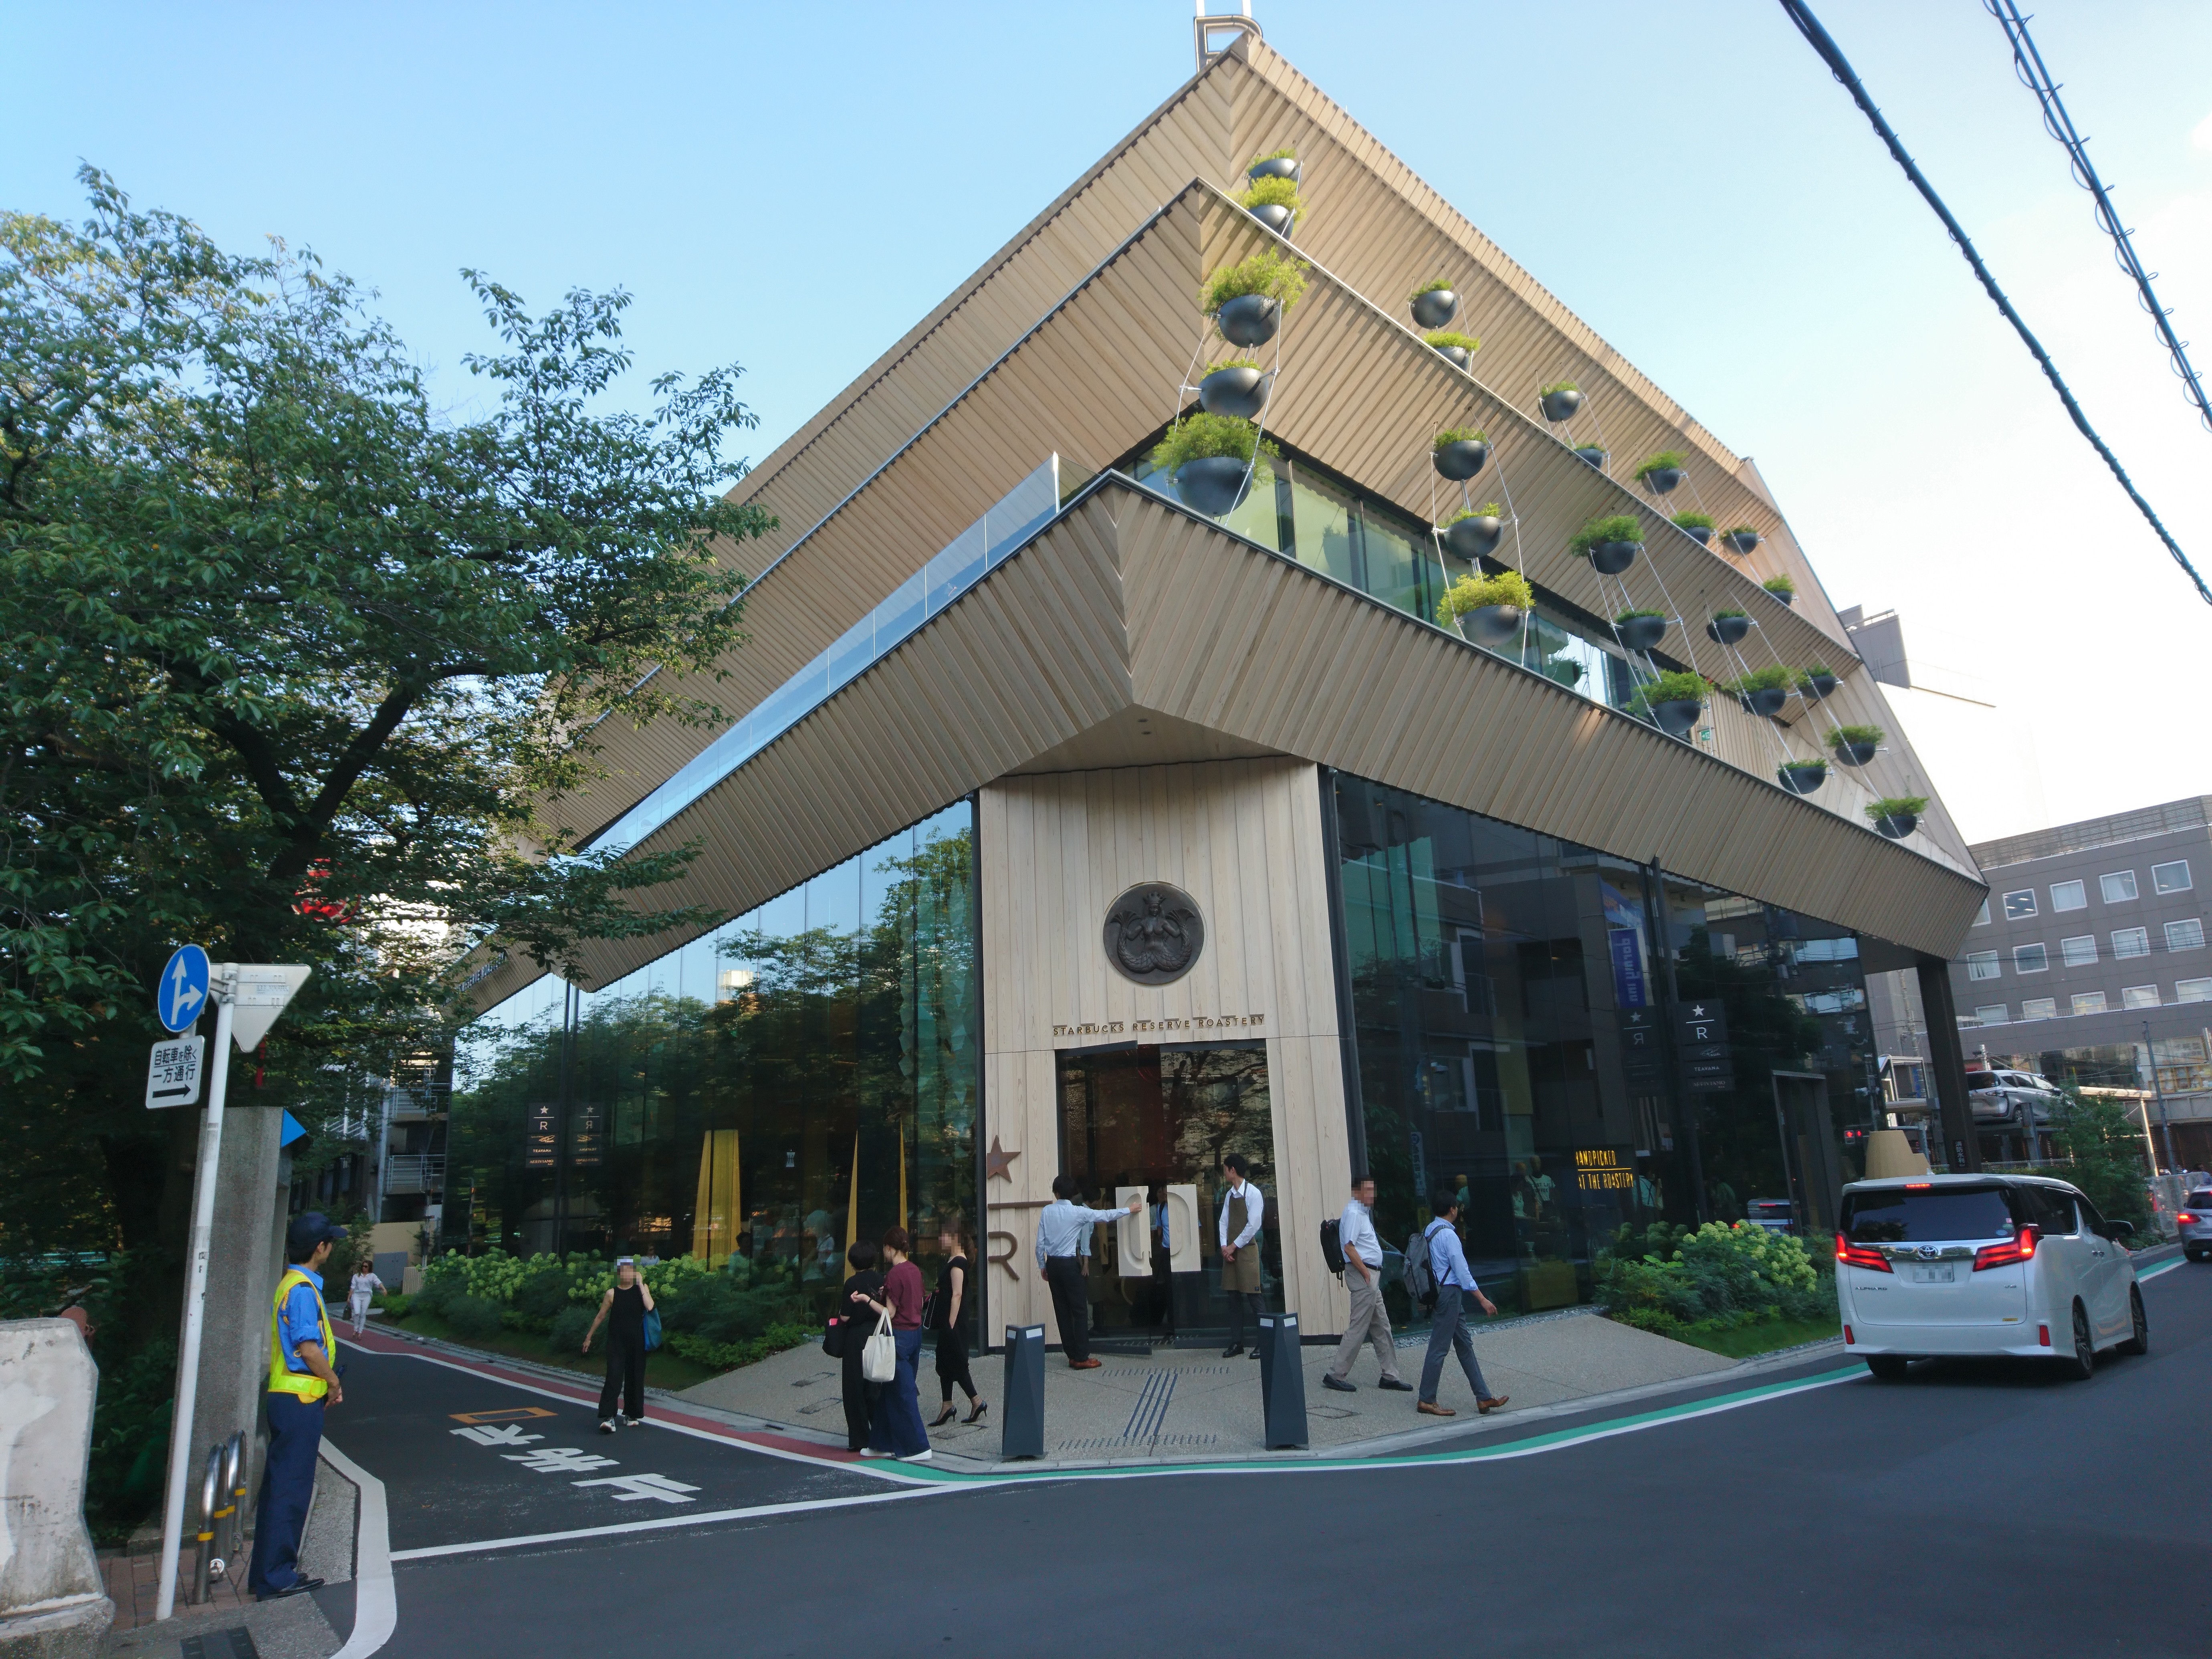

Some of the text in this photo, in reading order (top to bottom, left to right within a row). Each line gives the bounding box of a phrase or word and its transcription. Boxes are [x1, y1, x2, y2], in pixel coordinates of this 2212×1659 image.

[1053, 1016, 1264, 1036] STARBUCKS RESERVE ROASTERY
[1696, 1027, 1708, 1039] R
[154, 1044, 197, 1066] 自転車を除く
[153, 1064, 196, 1083] 一方通行
[539, 1121, 548, 1130] R
[1956, 1141, 1965, 1163] 消防水利
[1588, 1174, 1601, 1190] THE
[1603, 1173, 1634, 1189] ROASTERY
[987, 1231, 1020, 1282] R
[449, 1424, 702, 1503] 止まれ
